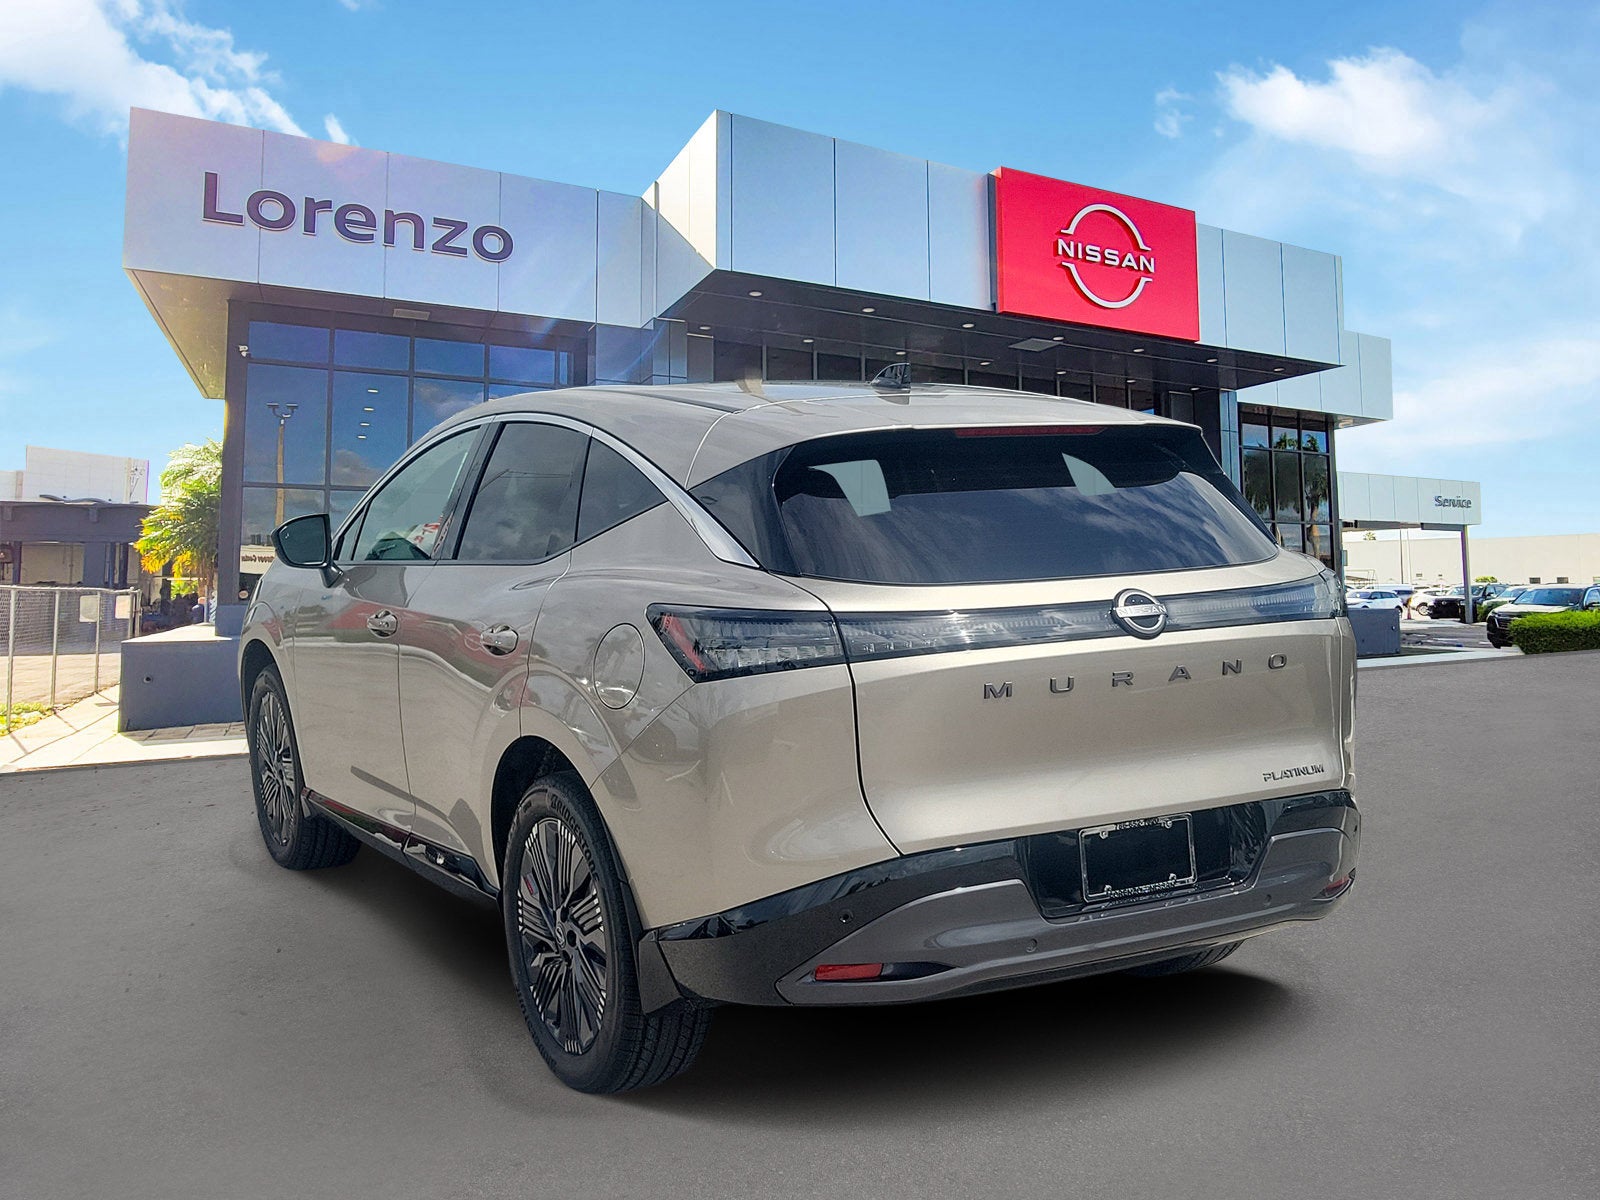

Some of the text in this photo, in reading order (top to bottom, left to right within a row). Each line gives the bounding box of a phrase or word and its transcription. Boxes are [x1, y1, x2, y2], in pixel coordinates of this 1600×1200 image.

[203, 172, 514, 262] Lorenzo
[1058, 238, 1155, 273] NISSAN
[1434, 496, 1472, 508] Service
[1118, 604, 1167, 617] NISSAN
[983, 652, 1288, 700] MURANO
[1262, 763, 1325, 782] PLATINUM
[550, 793, 600, 881] BRIDGESTONE
